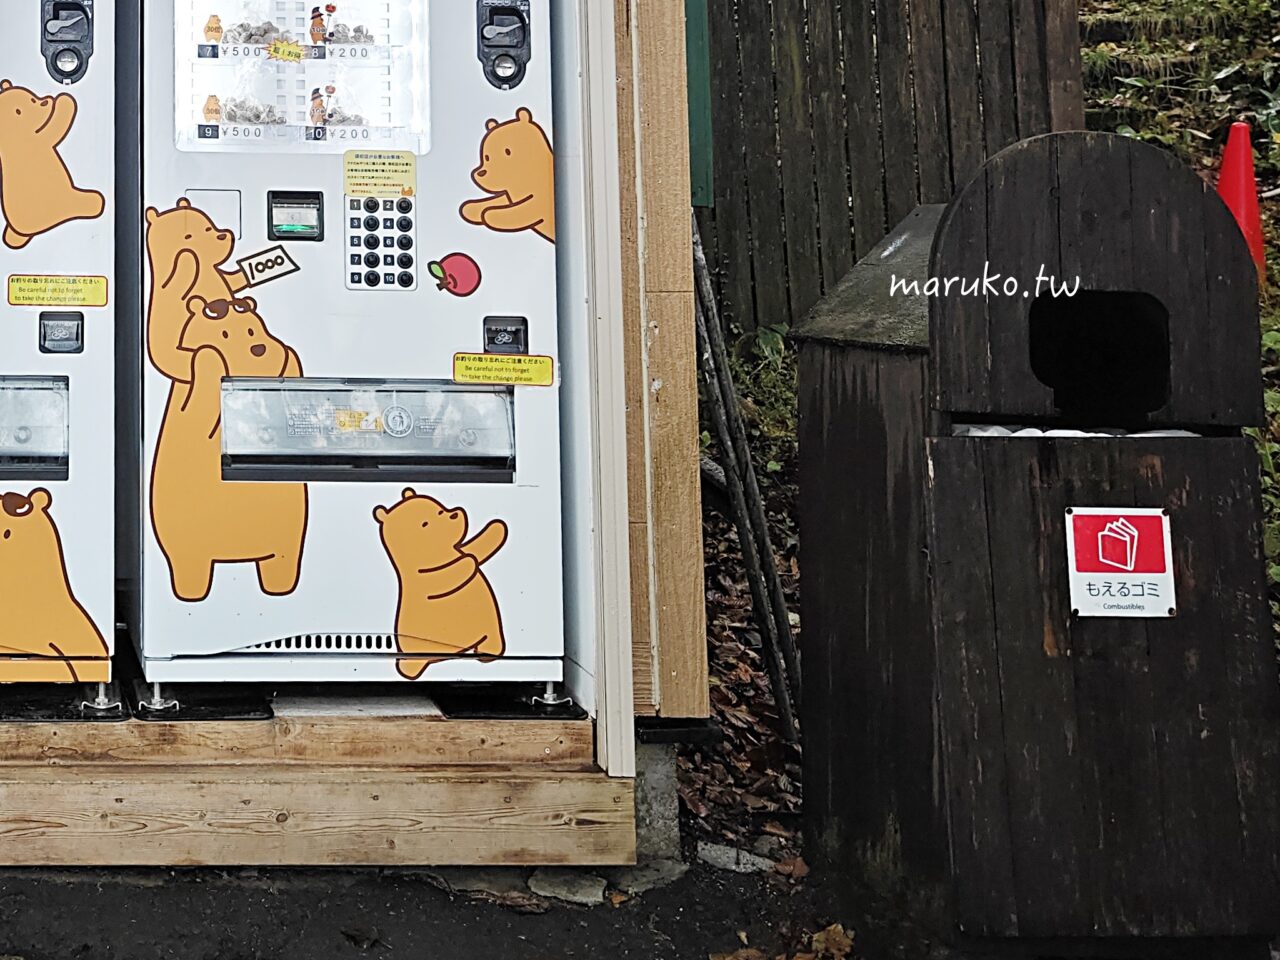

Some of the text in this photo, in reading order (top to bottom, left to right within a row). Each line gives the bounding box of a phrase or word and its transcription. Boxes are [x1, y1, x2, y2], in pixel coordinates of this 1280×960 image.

[206, 47, 261, 56] 7 ¥500
[312, 48, 368, 58] 8 ¥200
[205, 127, 261, 138] 9 ¥500
[310, 129, 368, 139] 10 ¥200
[249, 255, 284, 280] 1000
[1086, 581, 1160, 599] もえるゴミ
[1102, 603, 1145, 611] Combustibles
